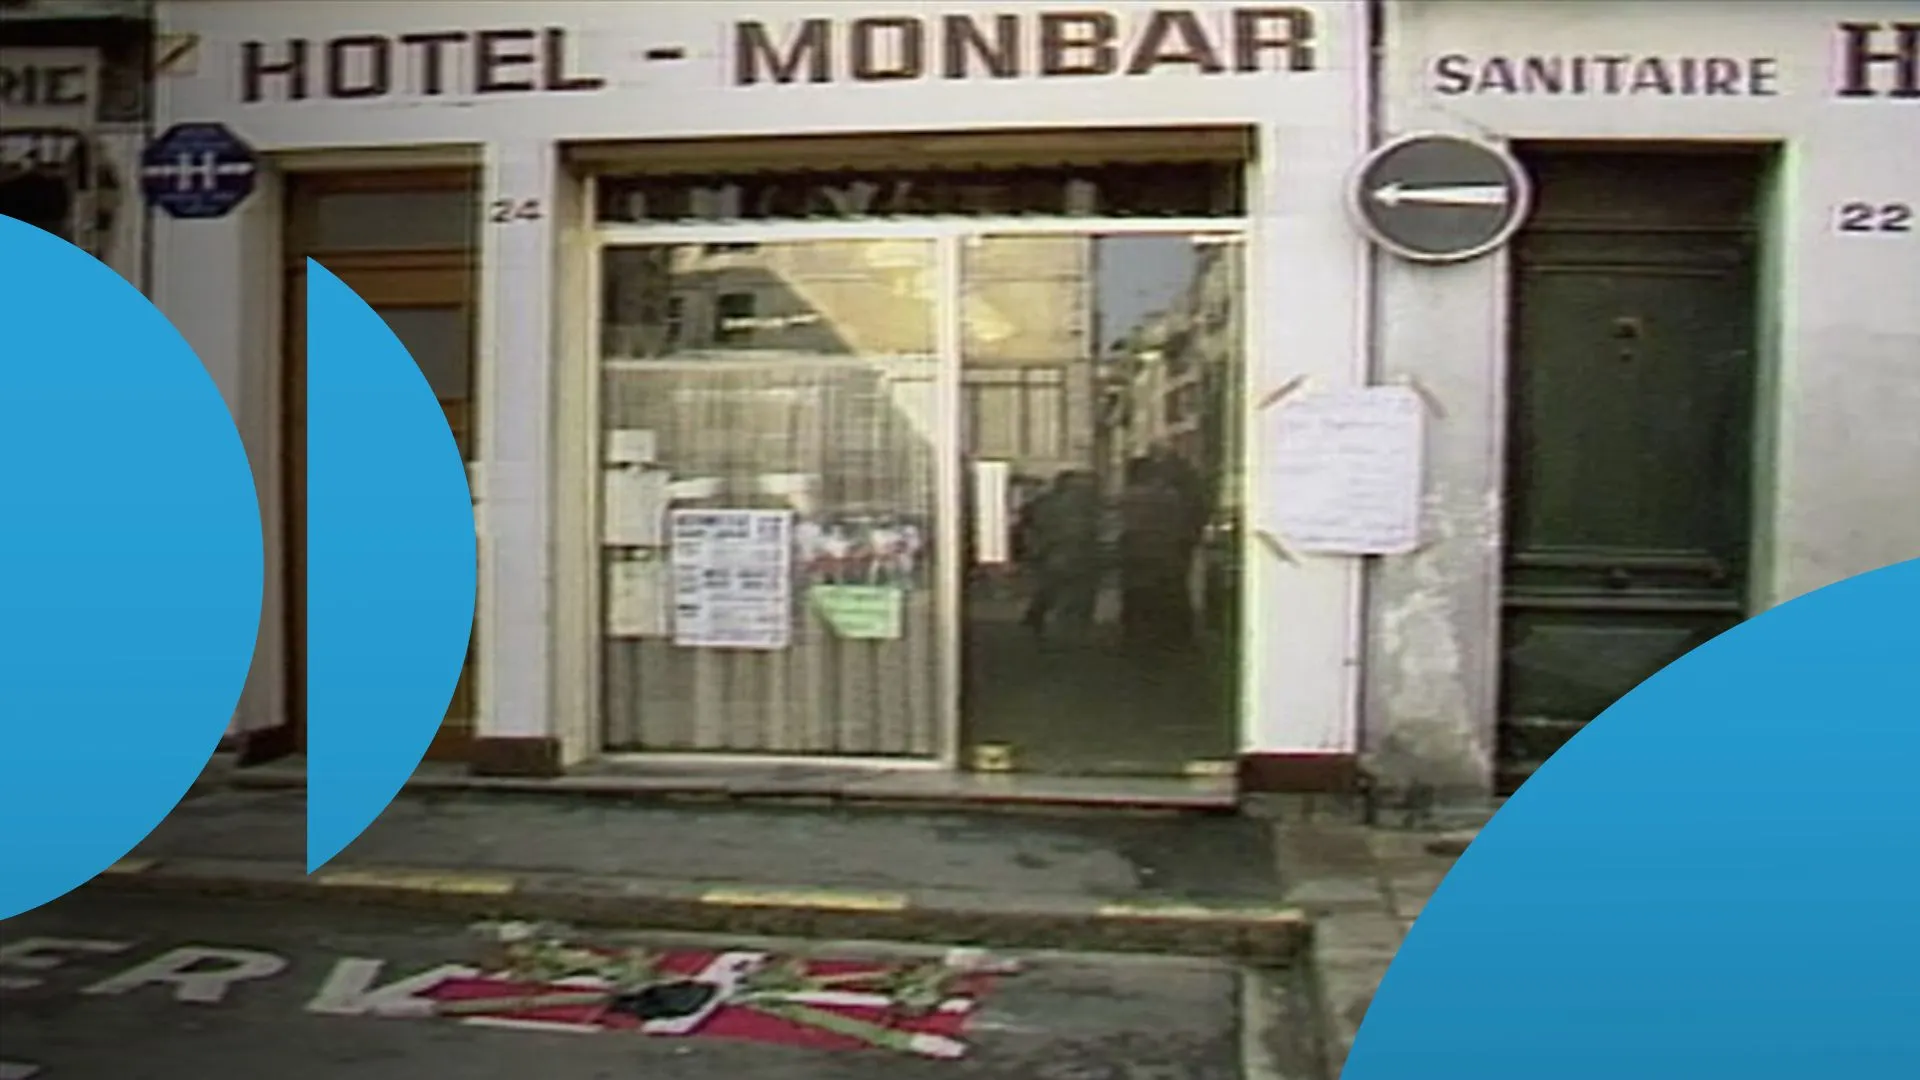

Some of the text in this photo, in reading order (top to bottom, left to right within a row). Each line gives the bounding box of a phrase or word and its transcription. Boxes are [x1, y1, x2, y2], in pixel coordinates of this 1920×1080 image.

[240, 27, 606, 103] HOTEL
[734, 6, 1317, 86] MONBAR
[1434, 53, 1778, 97] SANITAIRE
[177, 150, 217, 192] H
[490, 199, 543, 224] 24
[1839, 203, 1912, 233] 22
